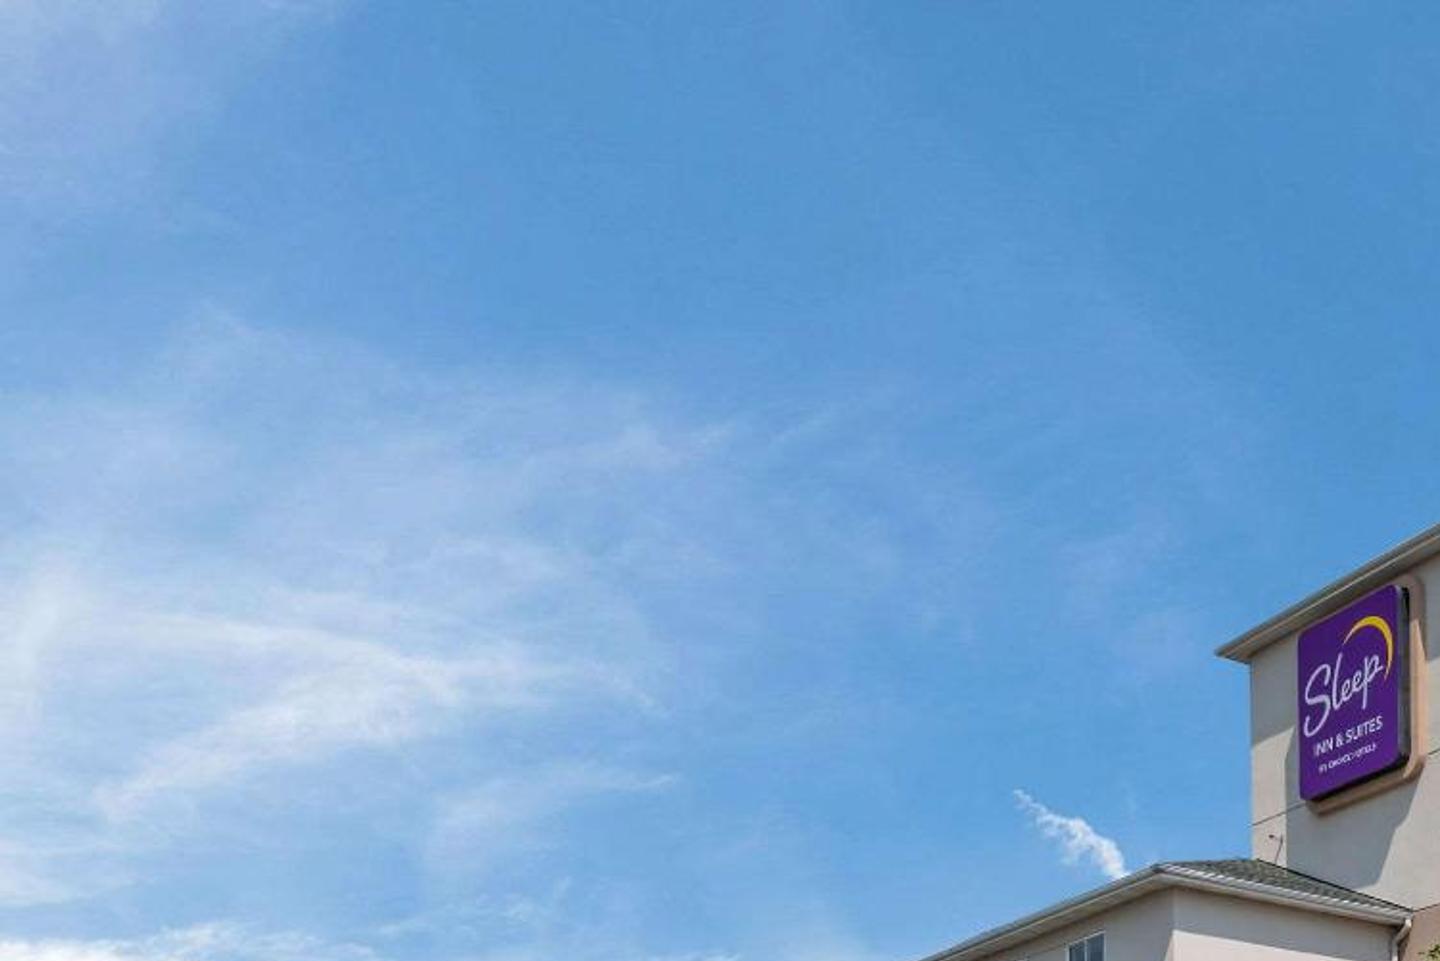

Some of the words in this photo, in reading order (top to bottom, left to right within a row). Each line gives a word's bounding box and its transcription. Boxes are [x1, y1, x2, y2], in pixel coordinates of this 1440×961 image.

[1303, 652, 1384, 738] Sleep
[1314, 737, 1334, 757] INN
[1336, 733, 1344, 748] &
[1345, 715, 1384, 744] SUITES
